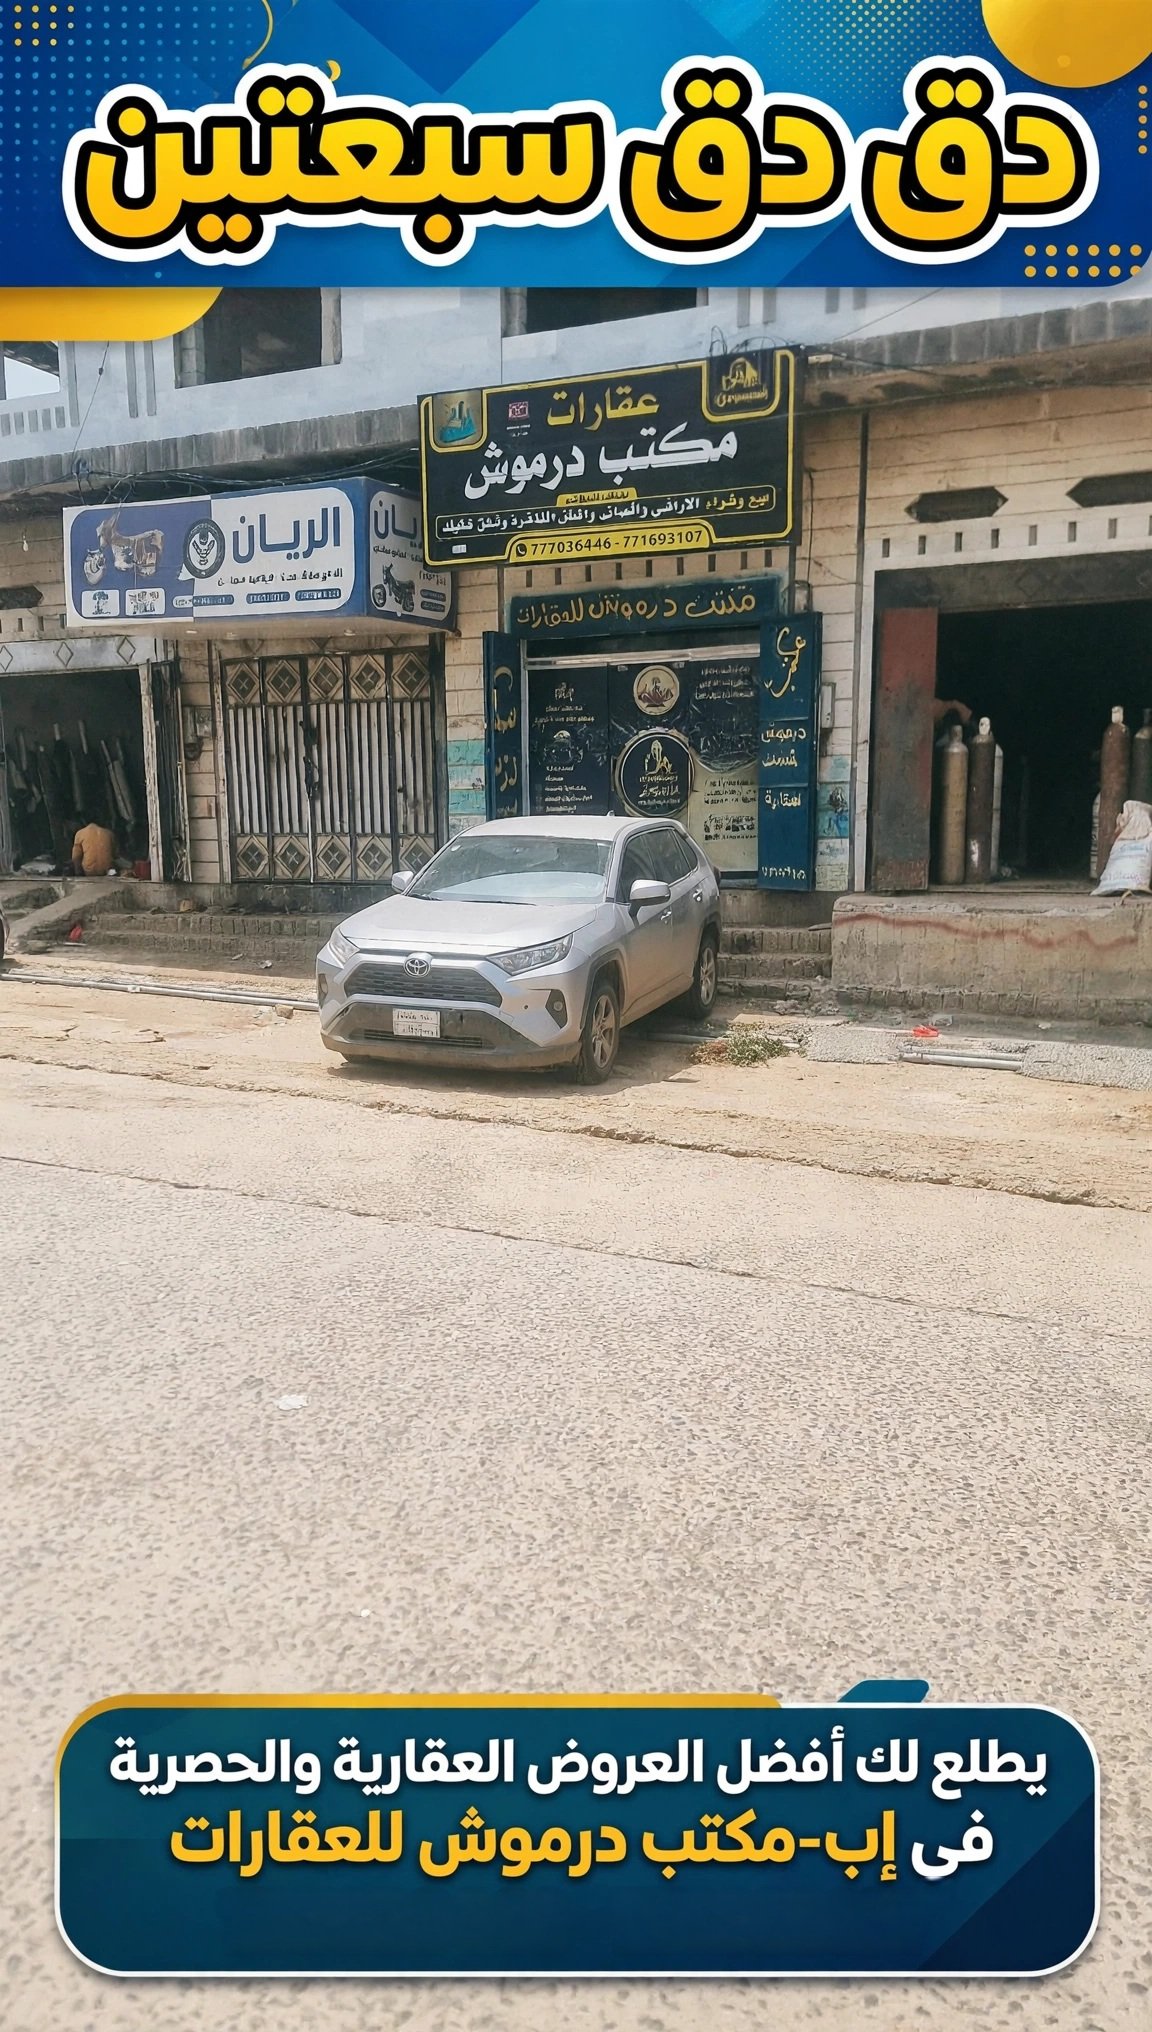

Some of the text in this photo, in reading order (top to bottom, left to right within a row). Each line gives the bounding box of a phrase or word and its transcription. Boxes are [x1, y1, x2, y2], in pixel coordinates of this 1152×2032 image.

[547, 384, 660, 432] عقارات
[464, 421, 738, 499] مكتب درموش
[232, 506, 341, 564] الريان
[531, 537, 611, 556] 777036446
[623, 530, 703, 548] 771693107
